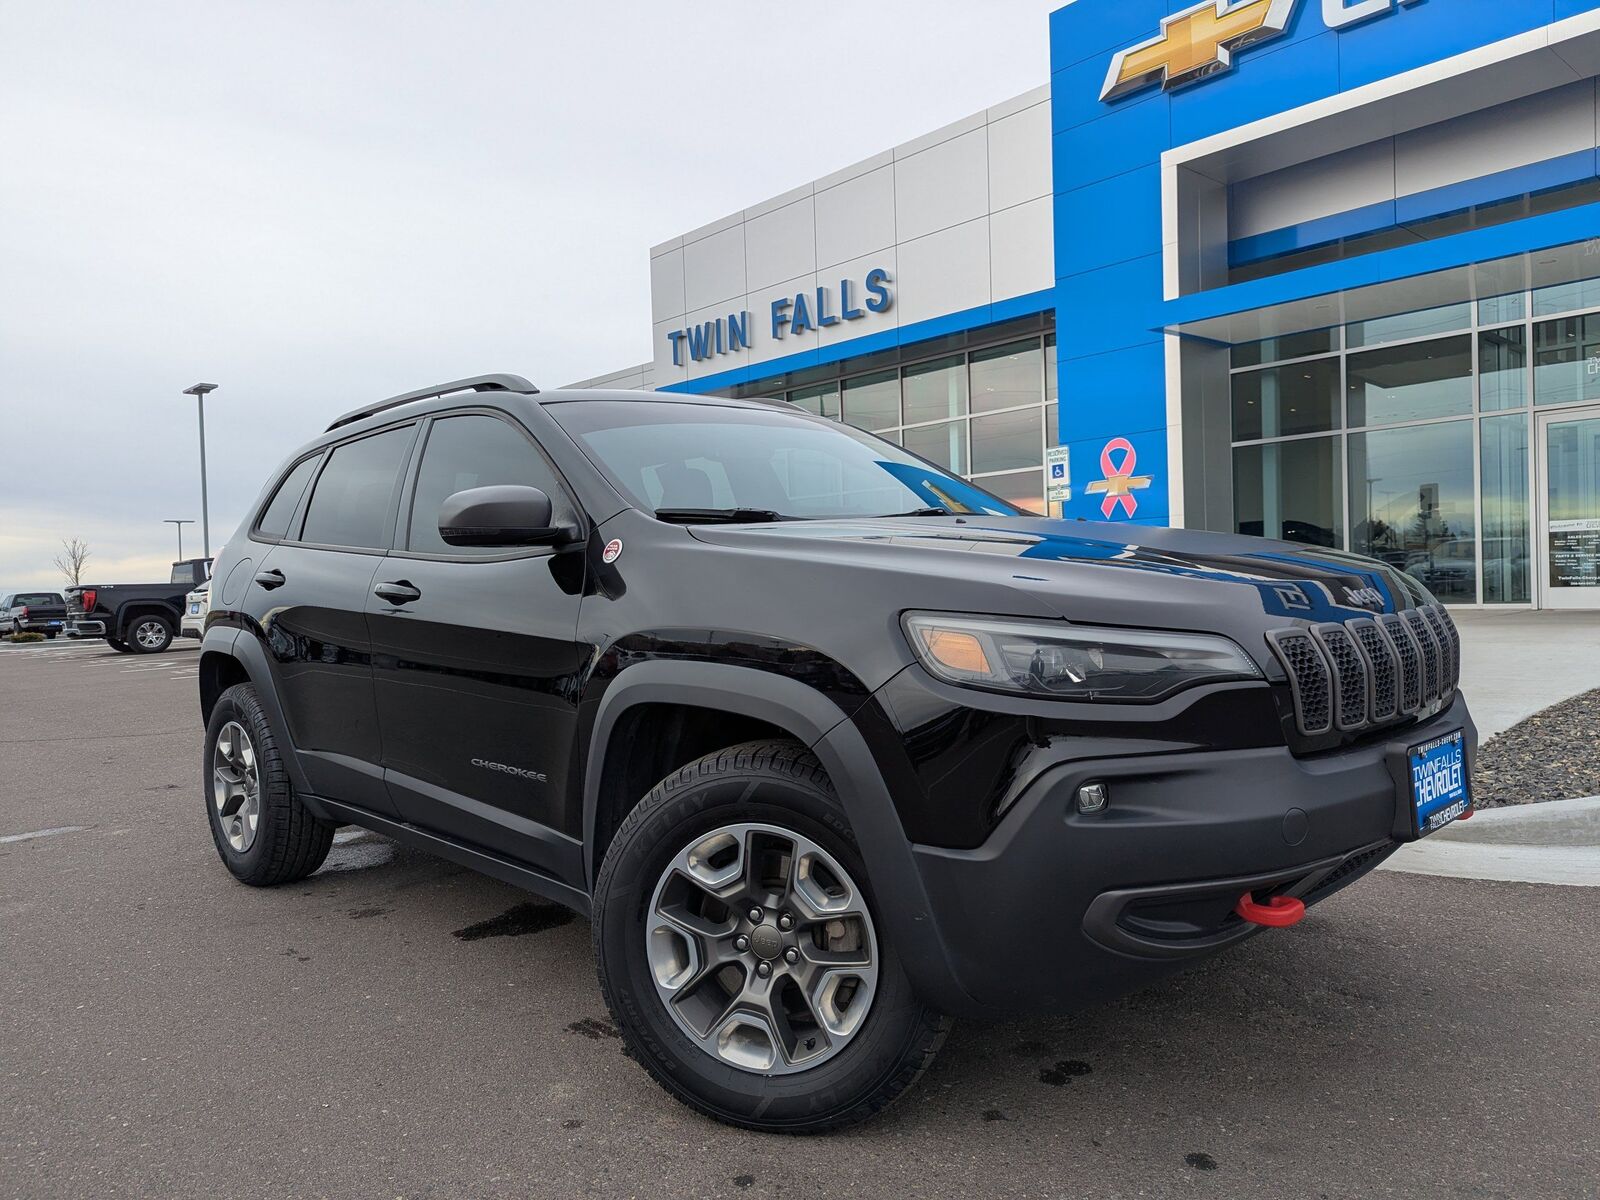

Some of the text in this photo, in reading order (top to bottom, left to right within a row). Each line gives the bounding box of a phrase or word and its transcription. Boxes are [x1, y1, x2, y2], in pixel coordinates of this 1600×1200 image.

[667, 268, 894, 366] TWIN FALLS
[1342, 586, 1385, 607] Jeep
[471, 758, 548, 783] CHEROKEE
[1414, 763, 1462, 807] CHEVROLET
[754, 934, 777, 950] Jeep
